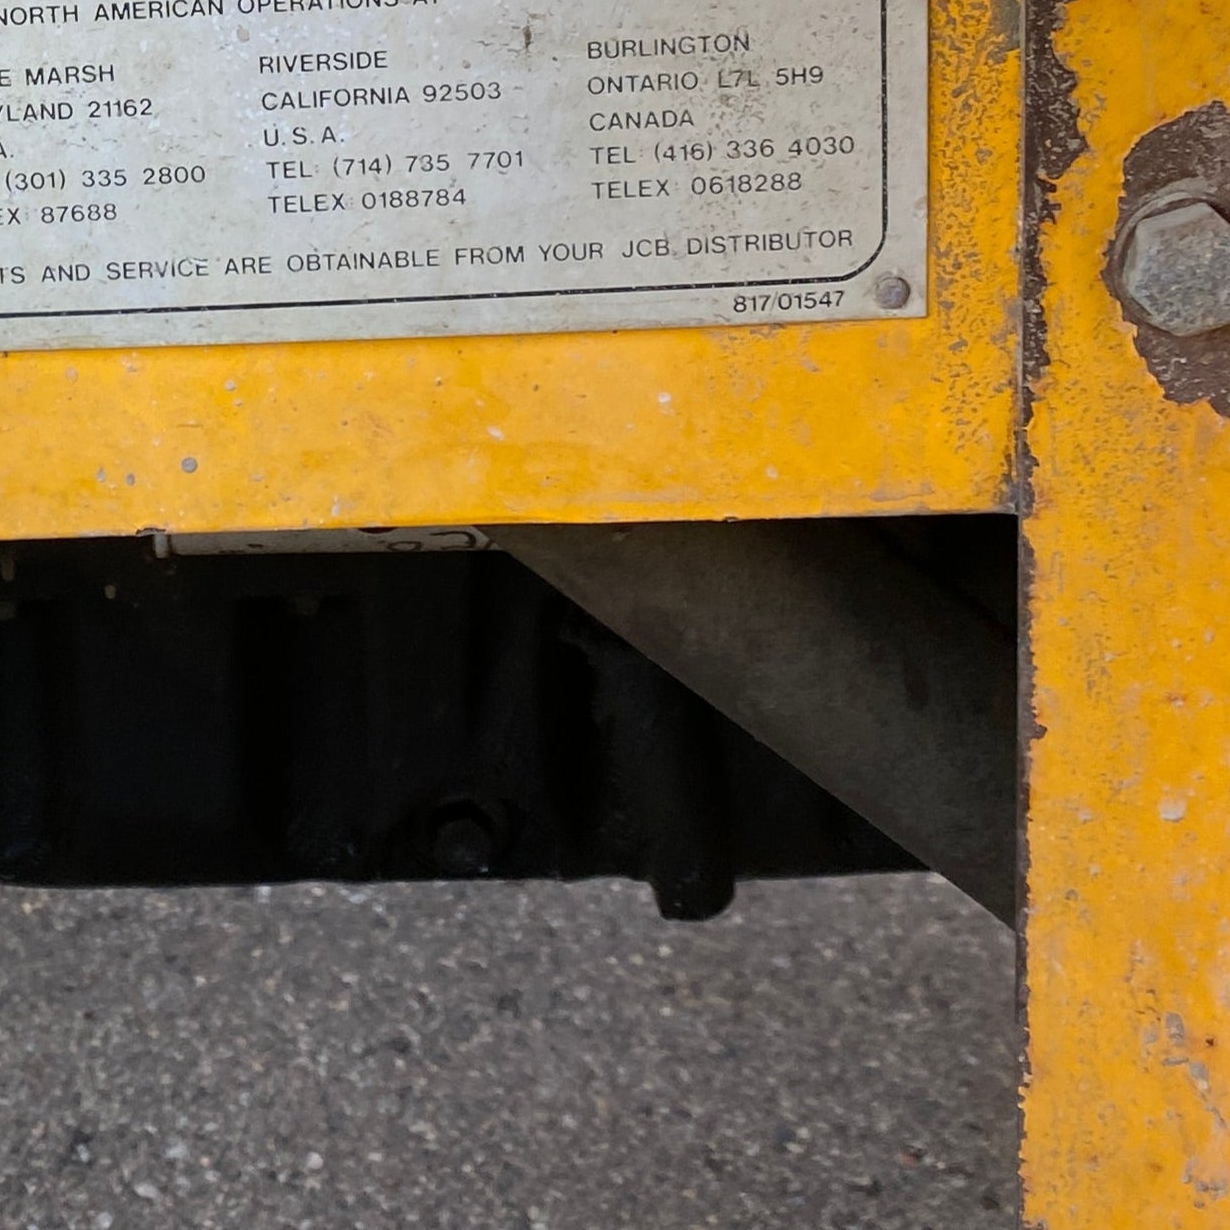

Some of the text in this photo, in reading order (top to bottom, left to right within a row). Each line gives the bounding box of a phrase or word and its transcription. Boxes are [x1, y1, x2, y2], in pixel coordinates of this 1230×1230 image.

[587, 33, 751, 60] BURLINGTON
[259, 50, 389, 74] RIVERSIDE
[25, 64, 115, 86] MARSH
[587, 65, 824, 96] ONTARIO L7L 5H9
[88, 97, 153, 119] 21162
[261, 81, 502, 111] CALIFORNIA 92503
[589, 109, 695, 132] CANADA
[654, 140, 713, 163] (416)
[726, 138, 775, 160] 336
[788, 135, 855, 157] 4030
[333, 153, 392, 178] (714)
[406, 154, 451, 173] 735
[467, 150, 524, 170] 7701
[5, 169, 66, 193] (301)
[81, 169, 128, 188] 335
[143, 165, 206, 186] 2800
[691, 172, 803, 196] 0618288
[361, 188, 467, 211] 0188784
[40, 203, 118, 224] 87688
[41, 263, 91, 283] AND
[106, 257, 210, 281] SERVICE
[224, 255, 273, 275] ARE
[287, 248, 440, 272] OBTAINABLE
[455, 245, 525, 267] FROM
[538, 242, 604, 262] YOUR
[622, 238, 670, 259] JCB
[687, 229, 853, 256] DISTRIBUTOR
